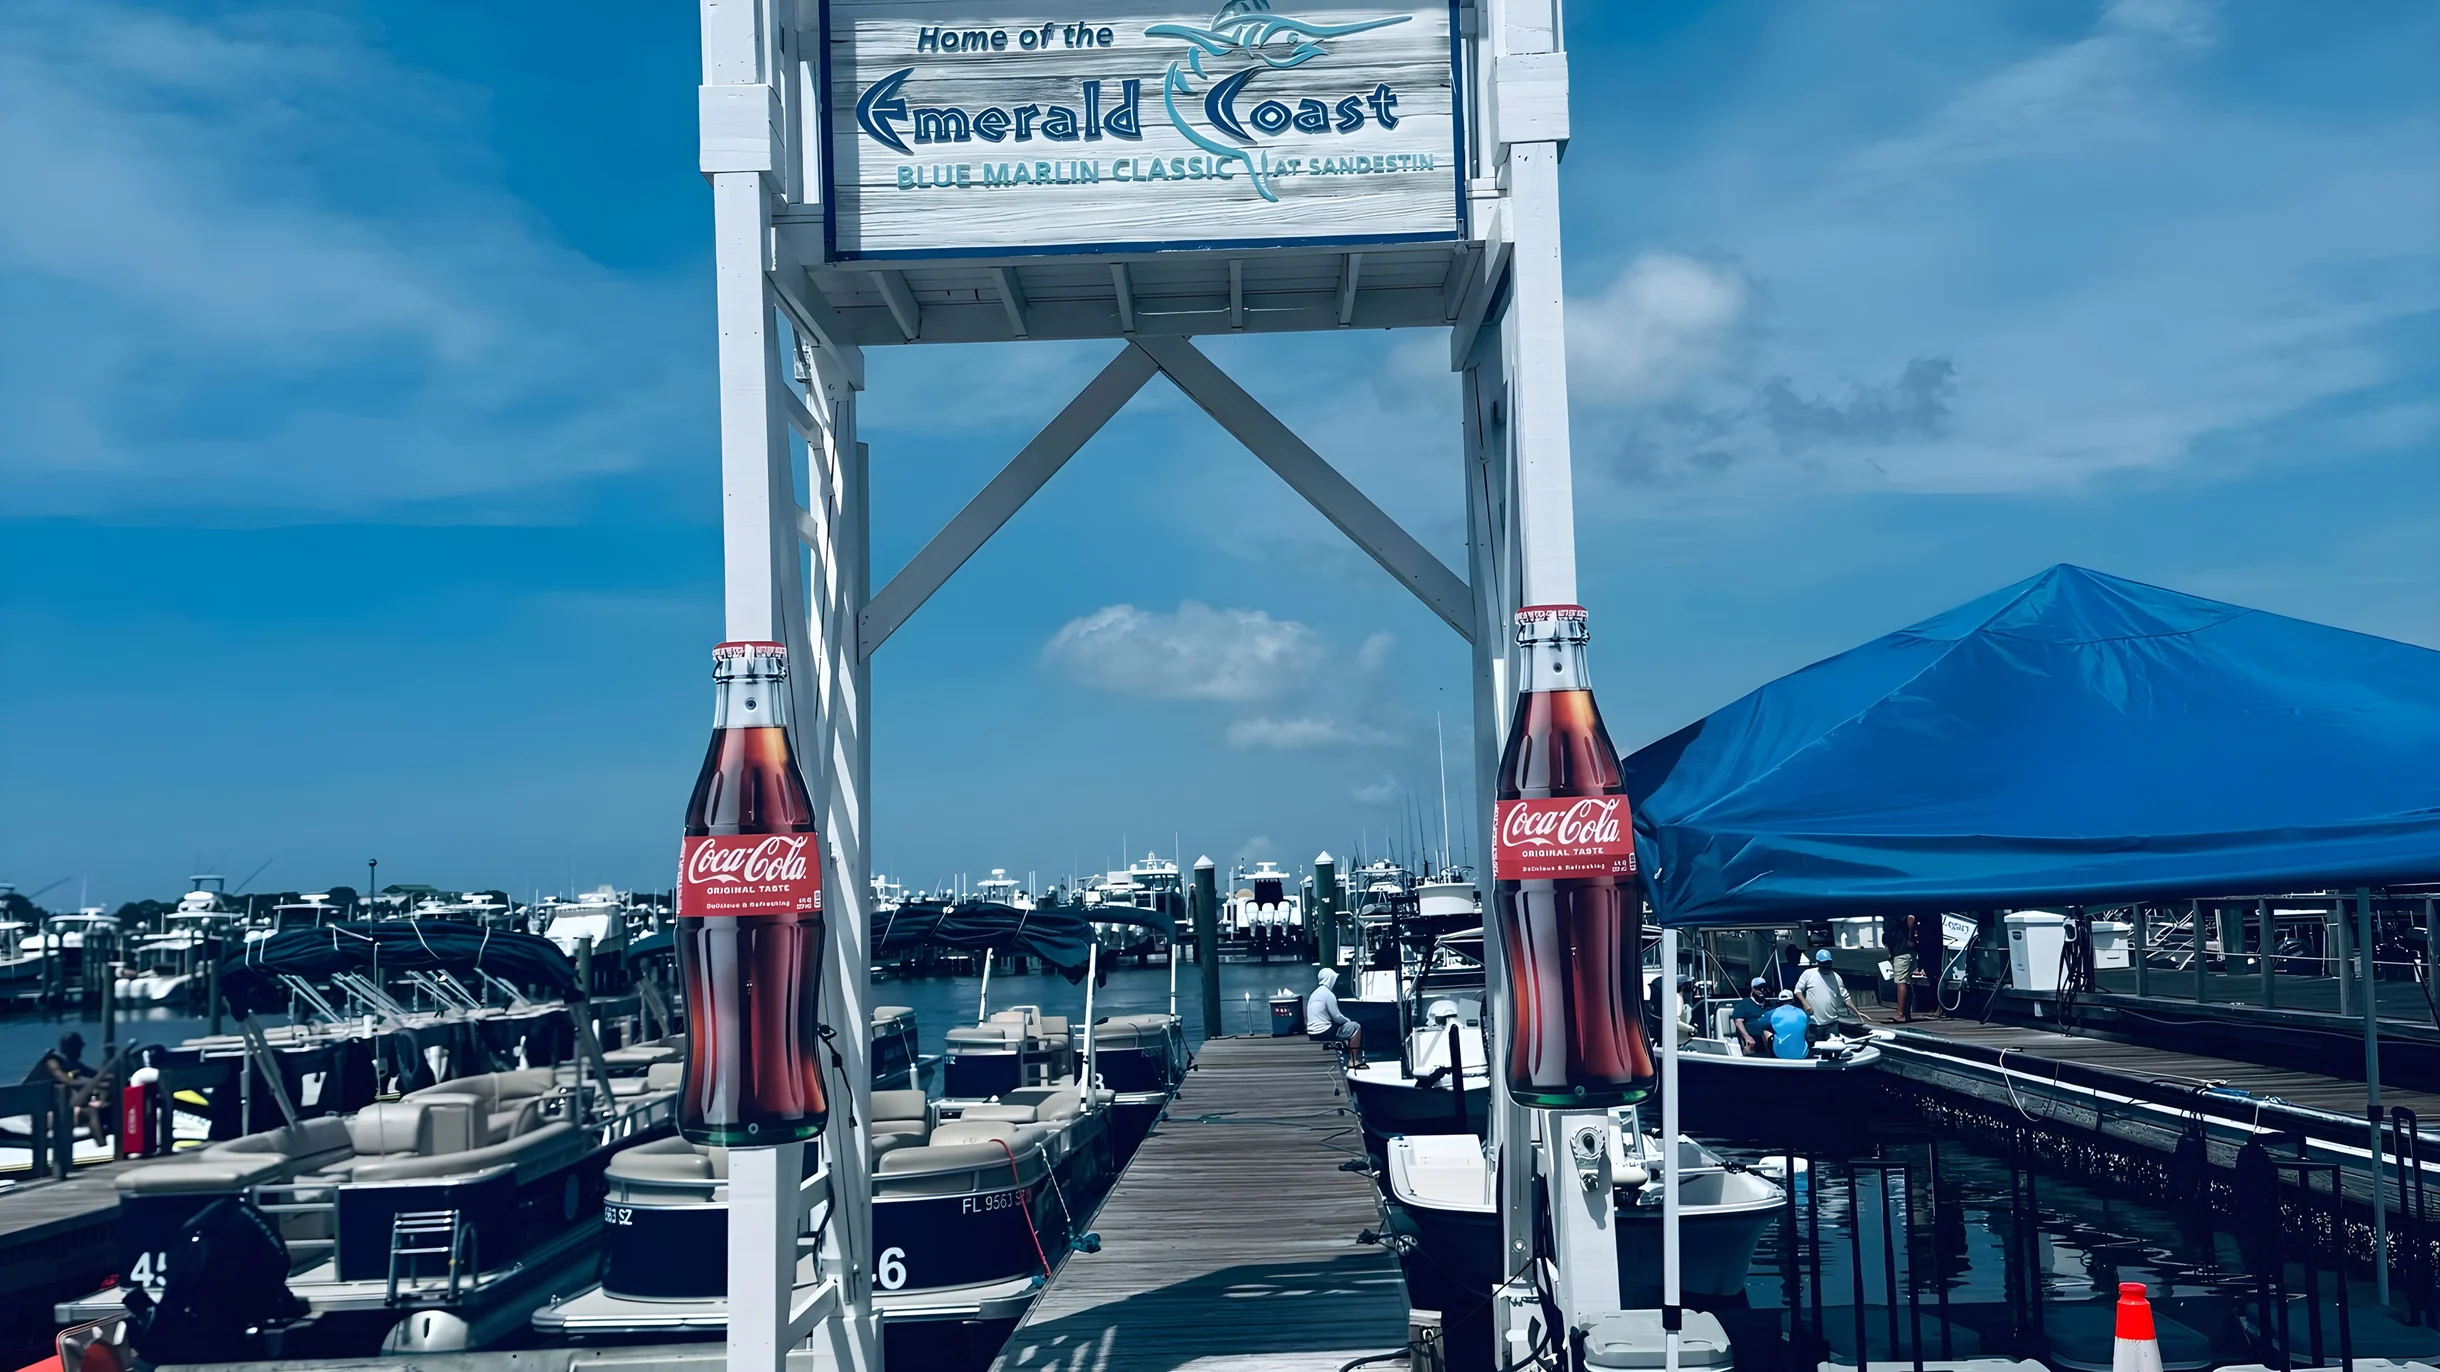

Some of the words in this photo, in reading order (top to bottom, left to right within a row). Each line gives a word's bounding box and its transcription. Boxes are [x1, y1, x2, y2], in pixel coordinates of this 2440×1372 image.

[917, 27, 1008, 53] Home
[1019, 22, 1056, 50] of
[1062, 22, 1114, 48] the
[855, 67, 1143, 156] Emerald
[1204, 65, 1400, 145] Coast
[896, 164, 971, 190] BLUE
[983, 160, 1099, 187] MARLIN
[1112, 156, 1233, 182] CLASSIC
[1273, 158, 1300, 178] AT
[1309, 153, 1435, 176] SANDESTIN
[1502, 798, 1620, 847] Coca-Cola
[688, 835, 808, 884] Coca-Cola
[962, 1197, 982, 1214] FL
